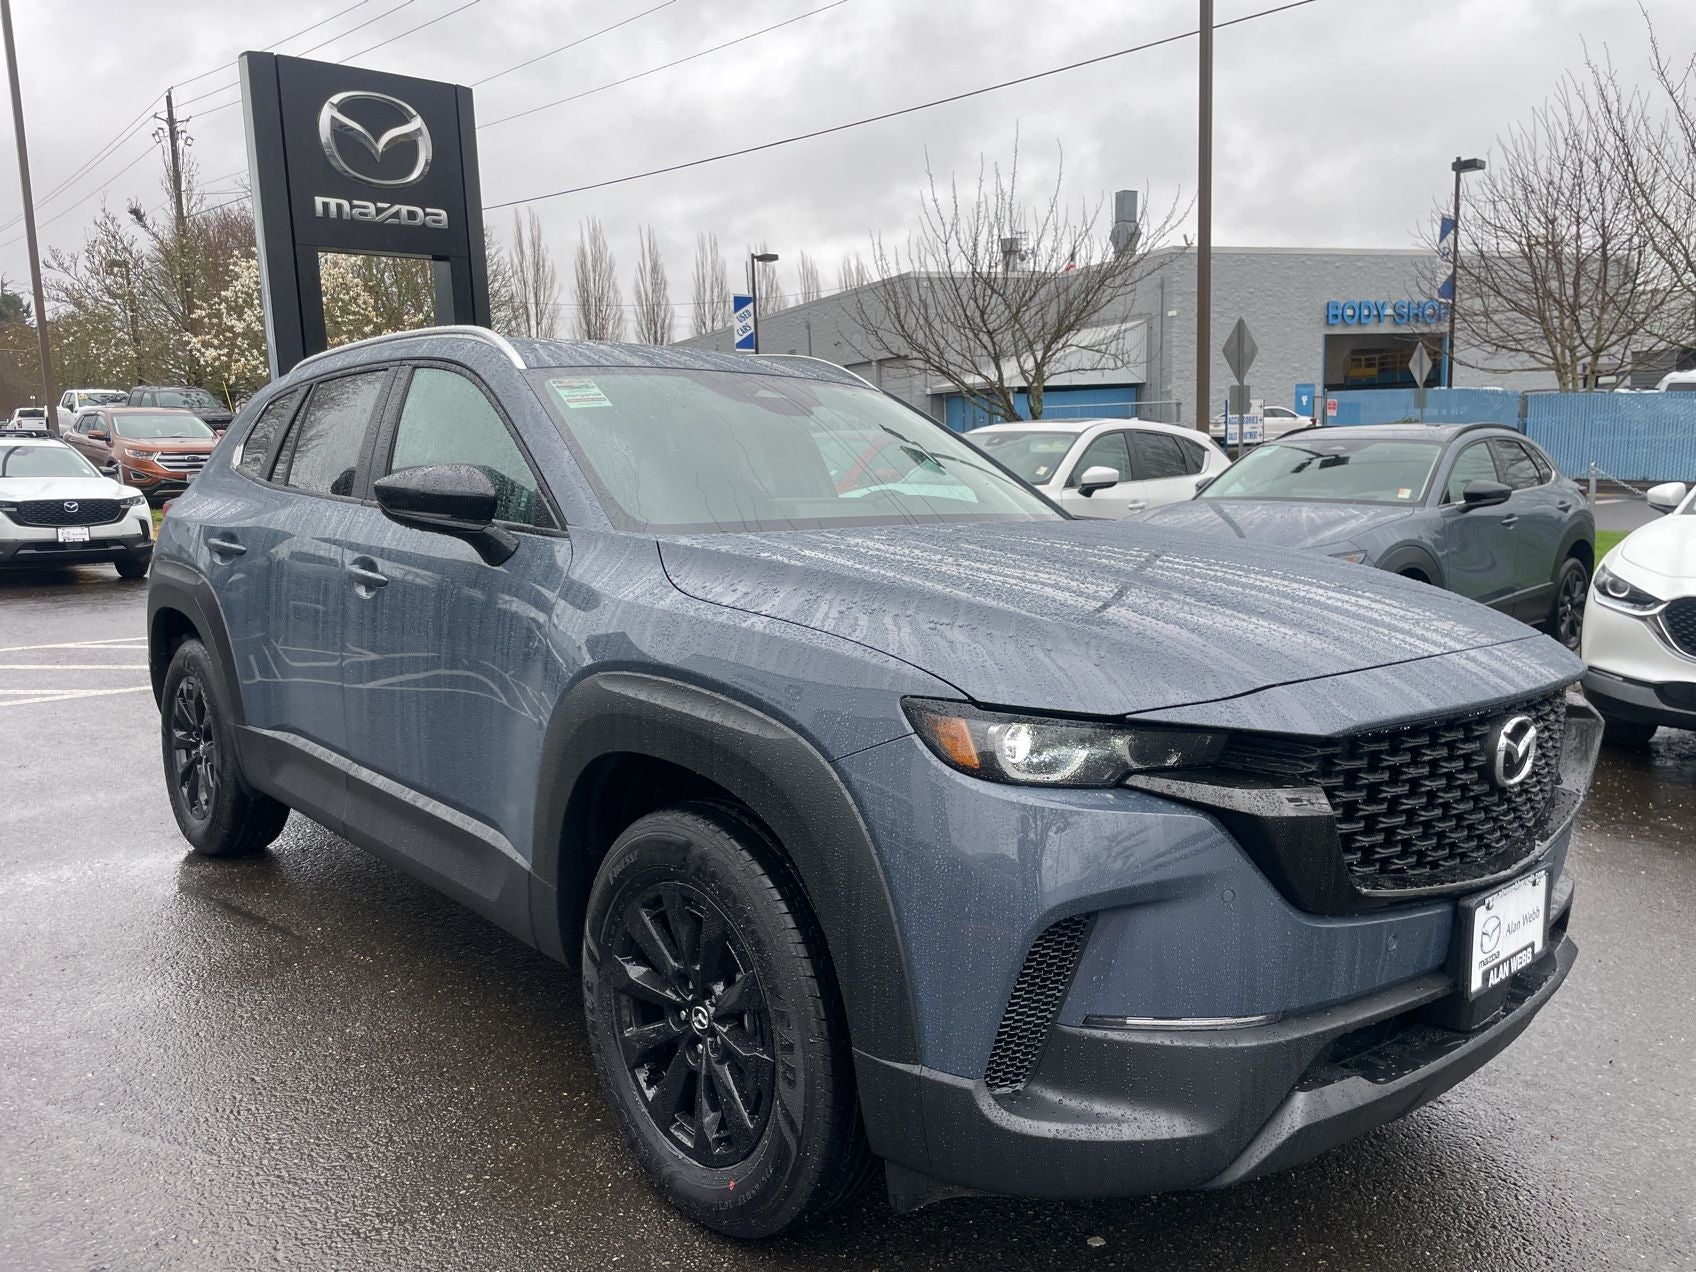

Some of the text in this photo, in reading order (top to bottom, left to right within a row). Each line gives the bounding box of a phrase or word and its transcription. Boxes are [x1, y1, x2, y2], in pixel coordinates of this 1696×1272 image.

[313, 196, 449, 229] mazda
[736, 309, 752, 323] USED
[1326, 300, 1387, 325] BODY
[736, 323, 752, 337] CARS
[1228, 415, 1259, 425] ACCESORIES
[1505, 906, 1540, 937] Alan Webb
[1488, 947, 1533, 988] ALAN WEBB
